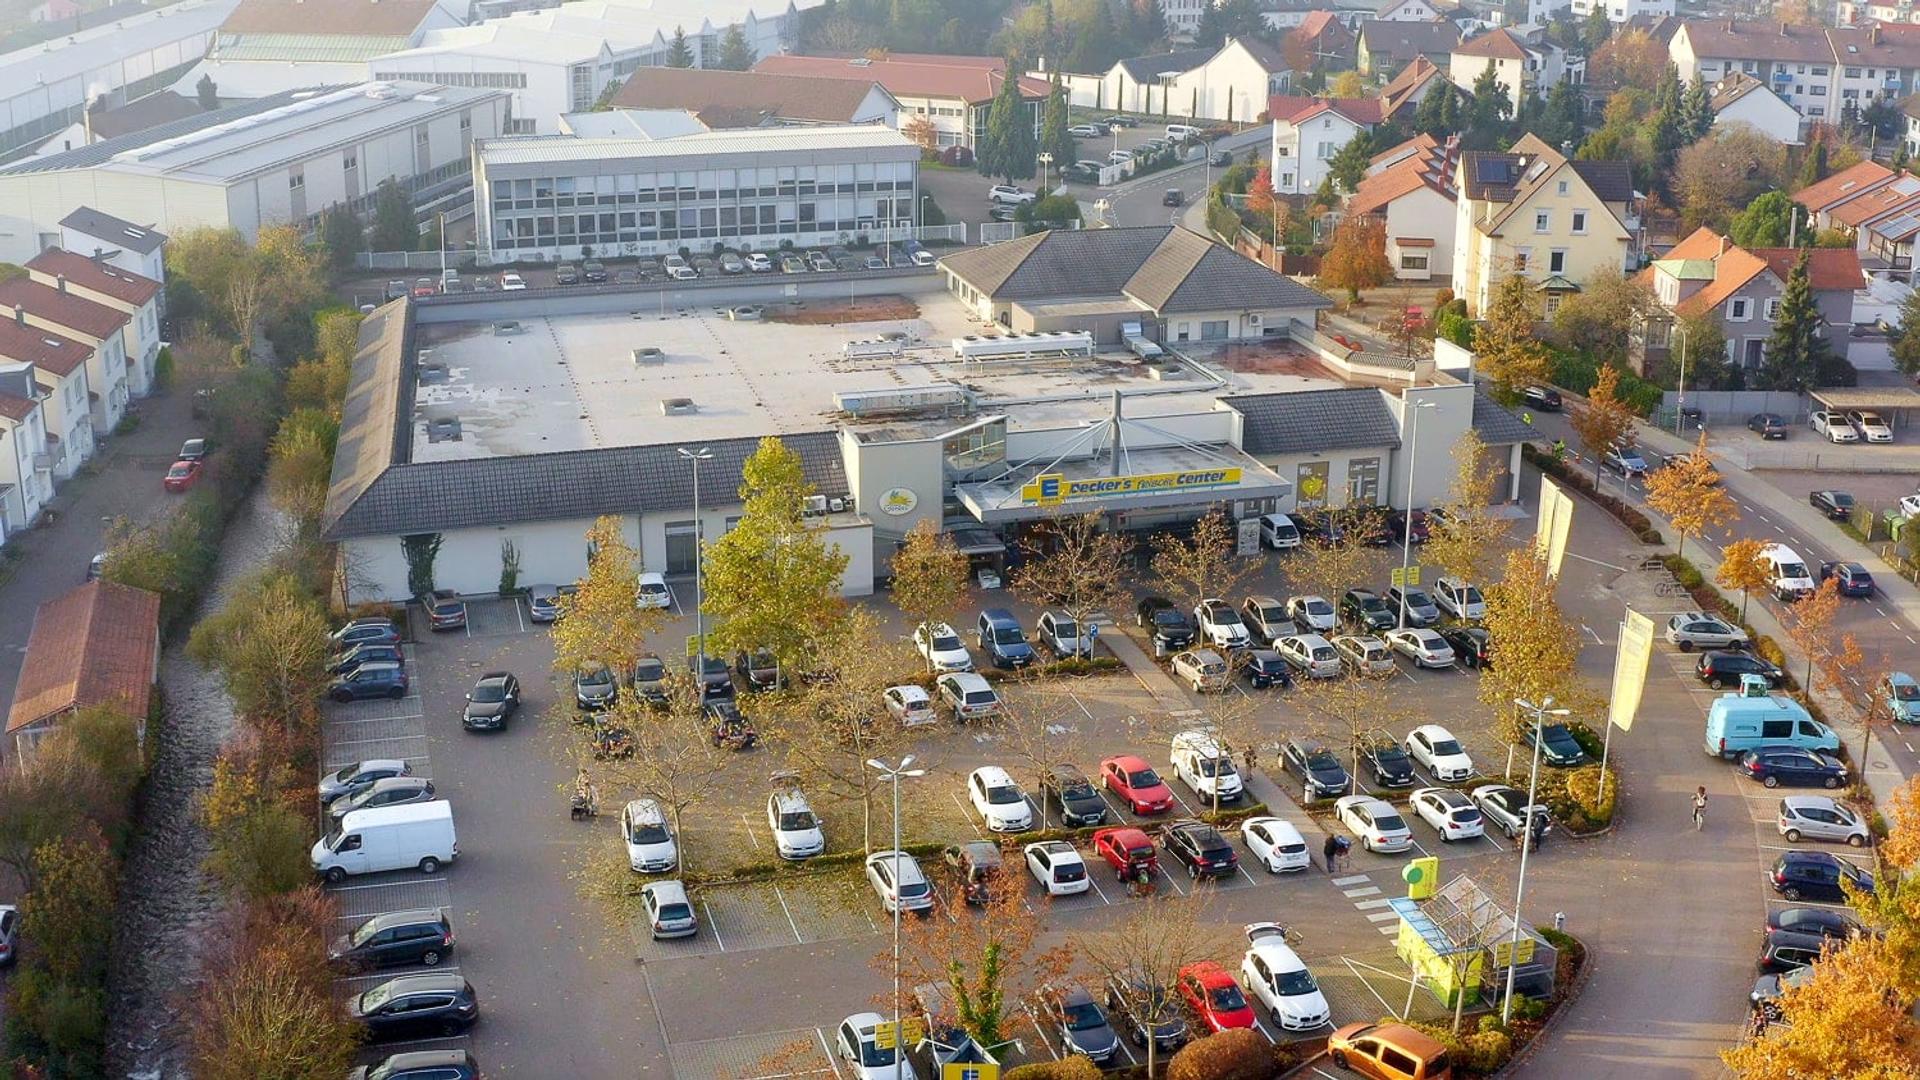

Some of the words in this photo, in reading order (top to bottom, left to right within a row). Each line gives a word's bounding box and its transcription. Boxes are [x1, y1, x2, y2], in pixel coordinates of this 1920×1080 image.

[1042, 479, 1059, 497] E
[1071, 477, 1132, 493] Decker's
[1177, 471, 1227, 485] Center
